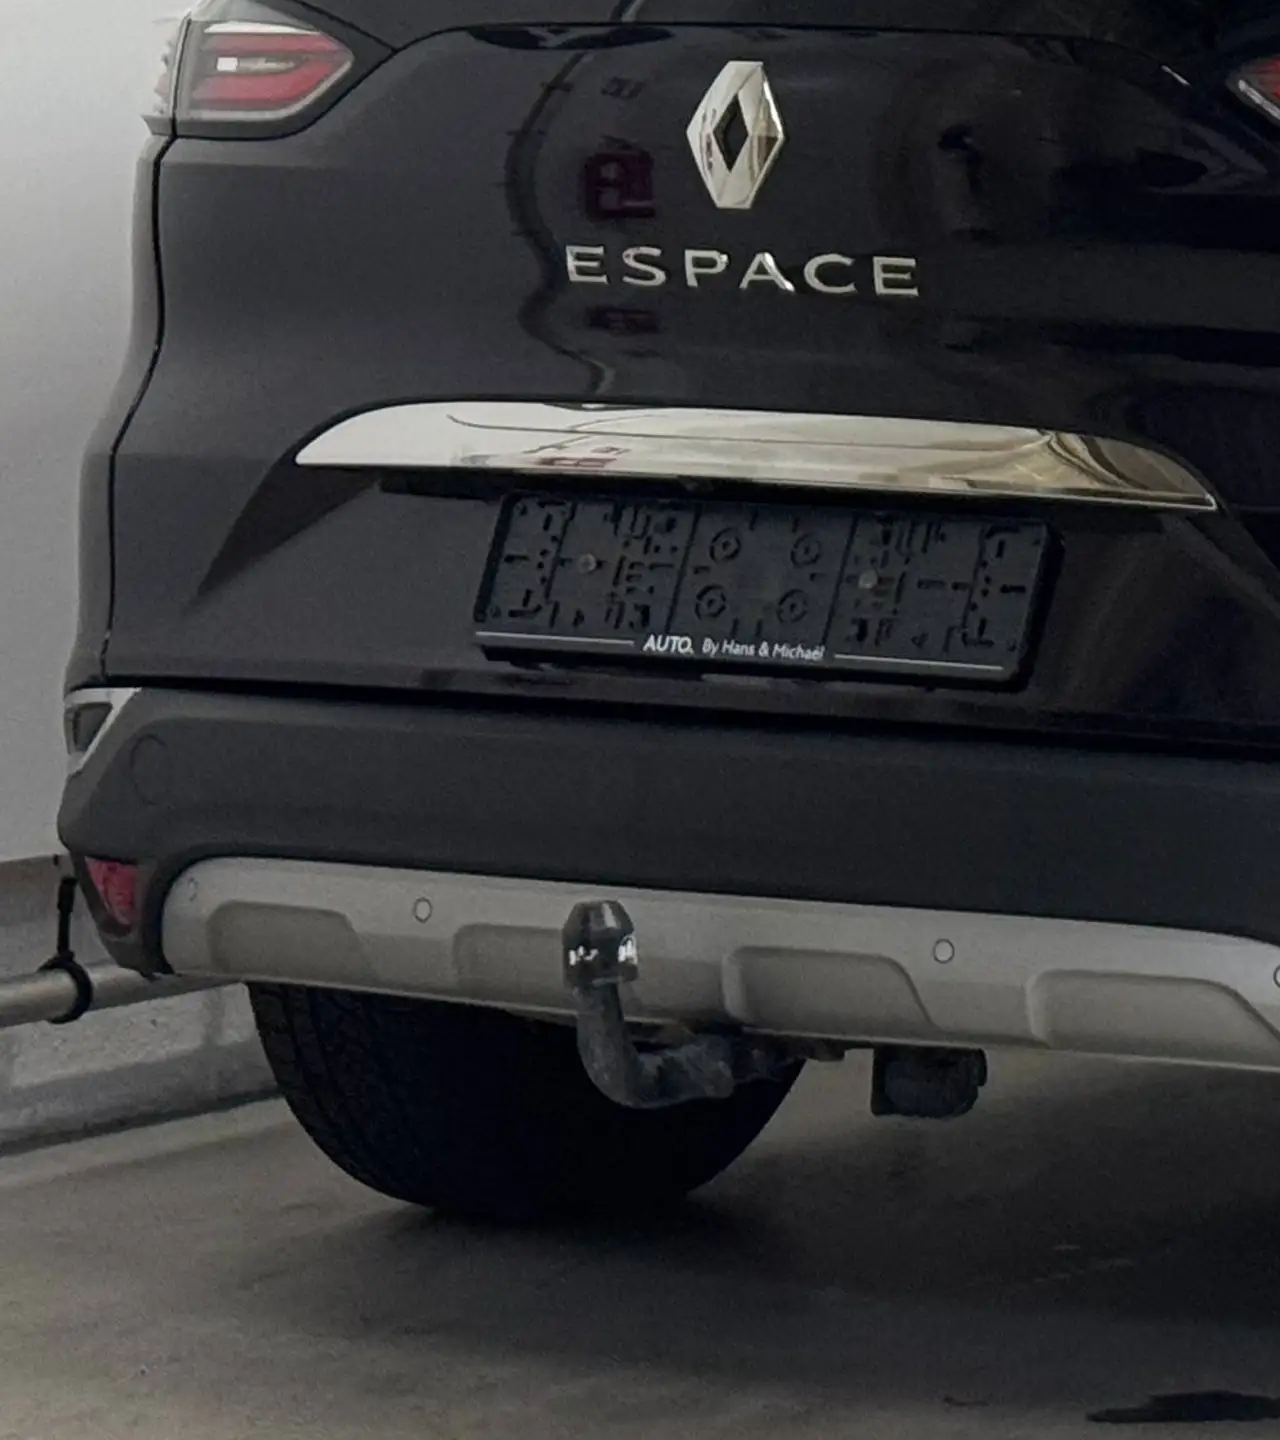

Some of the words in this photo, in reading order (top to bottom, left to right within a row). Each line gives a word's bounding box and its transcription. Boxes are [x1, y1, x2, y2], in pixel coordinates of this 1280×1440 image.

[565, 244, 920, 297] ESPACE
[642, 633, 695, 655] AUTO.
[701, 637, 720, 658] By
[722, 638, 755, 657] Hans
[758, 641, 770, 657] &
